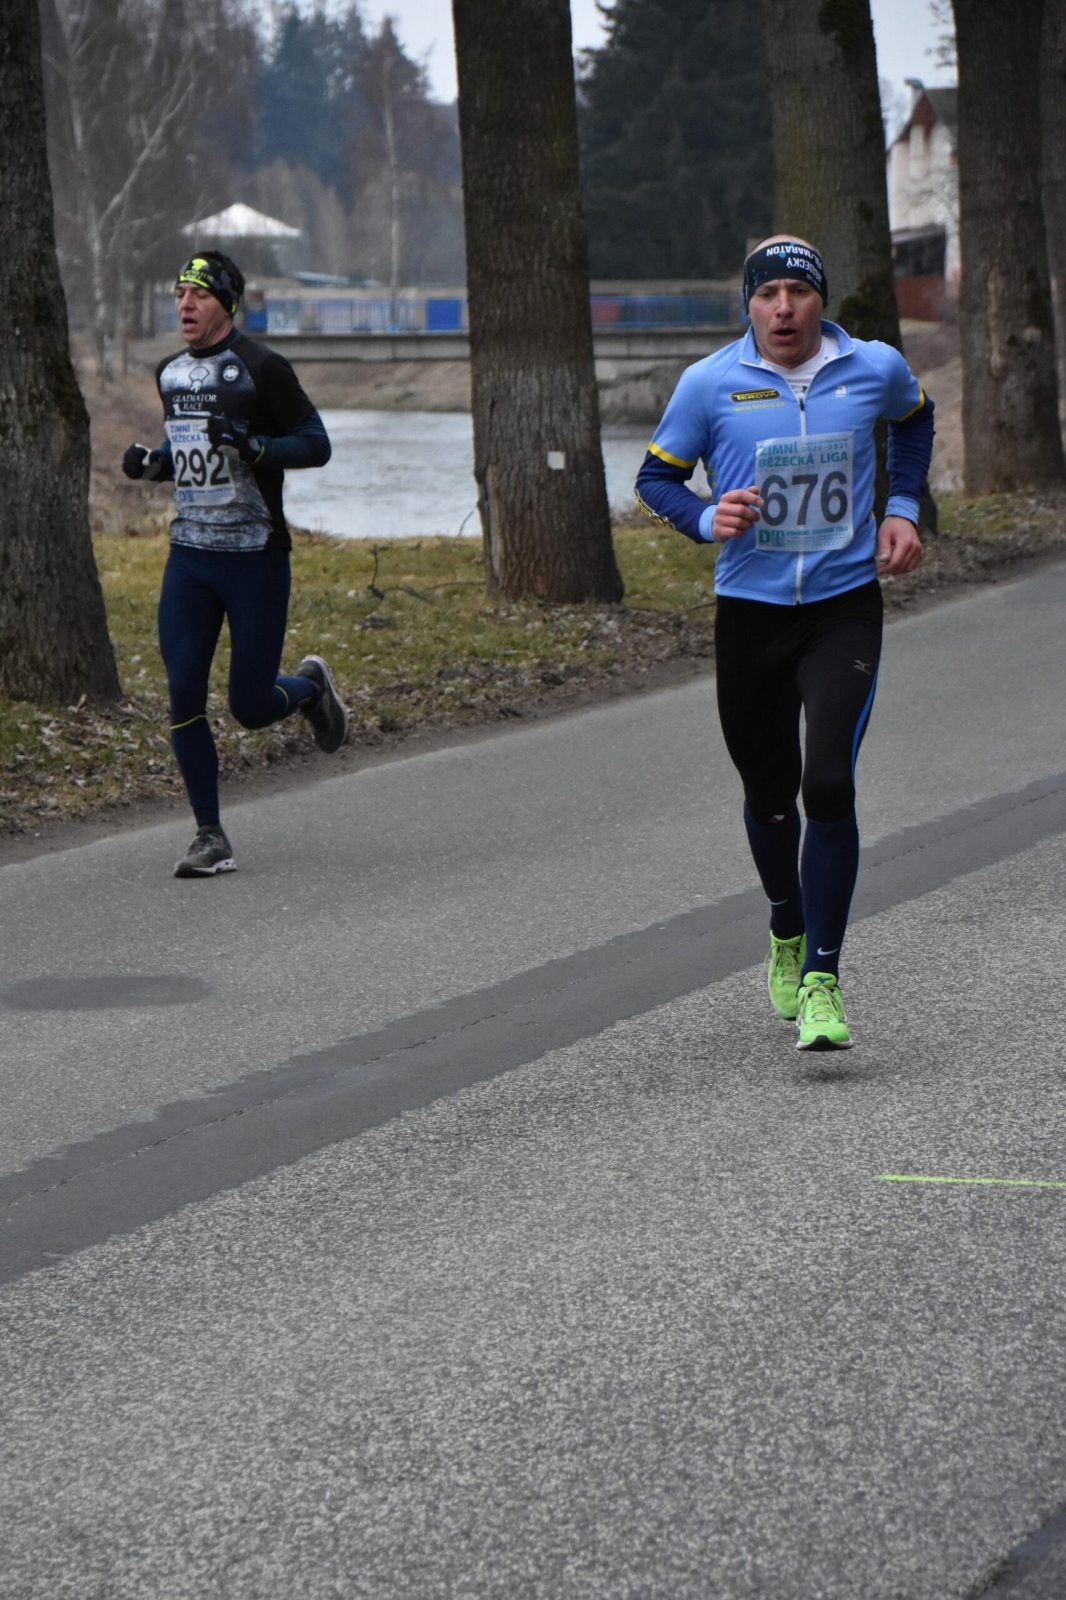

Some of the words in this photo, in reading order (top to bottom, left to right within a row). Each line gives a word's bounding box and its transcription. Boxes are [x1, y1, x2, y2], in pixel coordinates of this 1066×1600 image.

[172, 394, 218, 403] GLADIATOR
[733, 389, 777, 401] TEROVA
[182, 402, 203, 411] RACE
[170, 423, 191, 433] ZIMNÍ
[760, 441, 798, 456] ZIMNÍ
[758, 452, 815, 468] BĚŽECKÁ
[819, 451, 849, 463] LIGA
[175, 447, 230, 488] 292
[760, 471, 848, 526] 676
